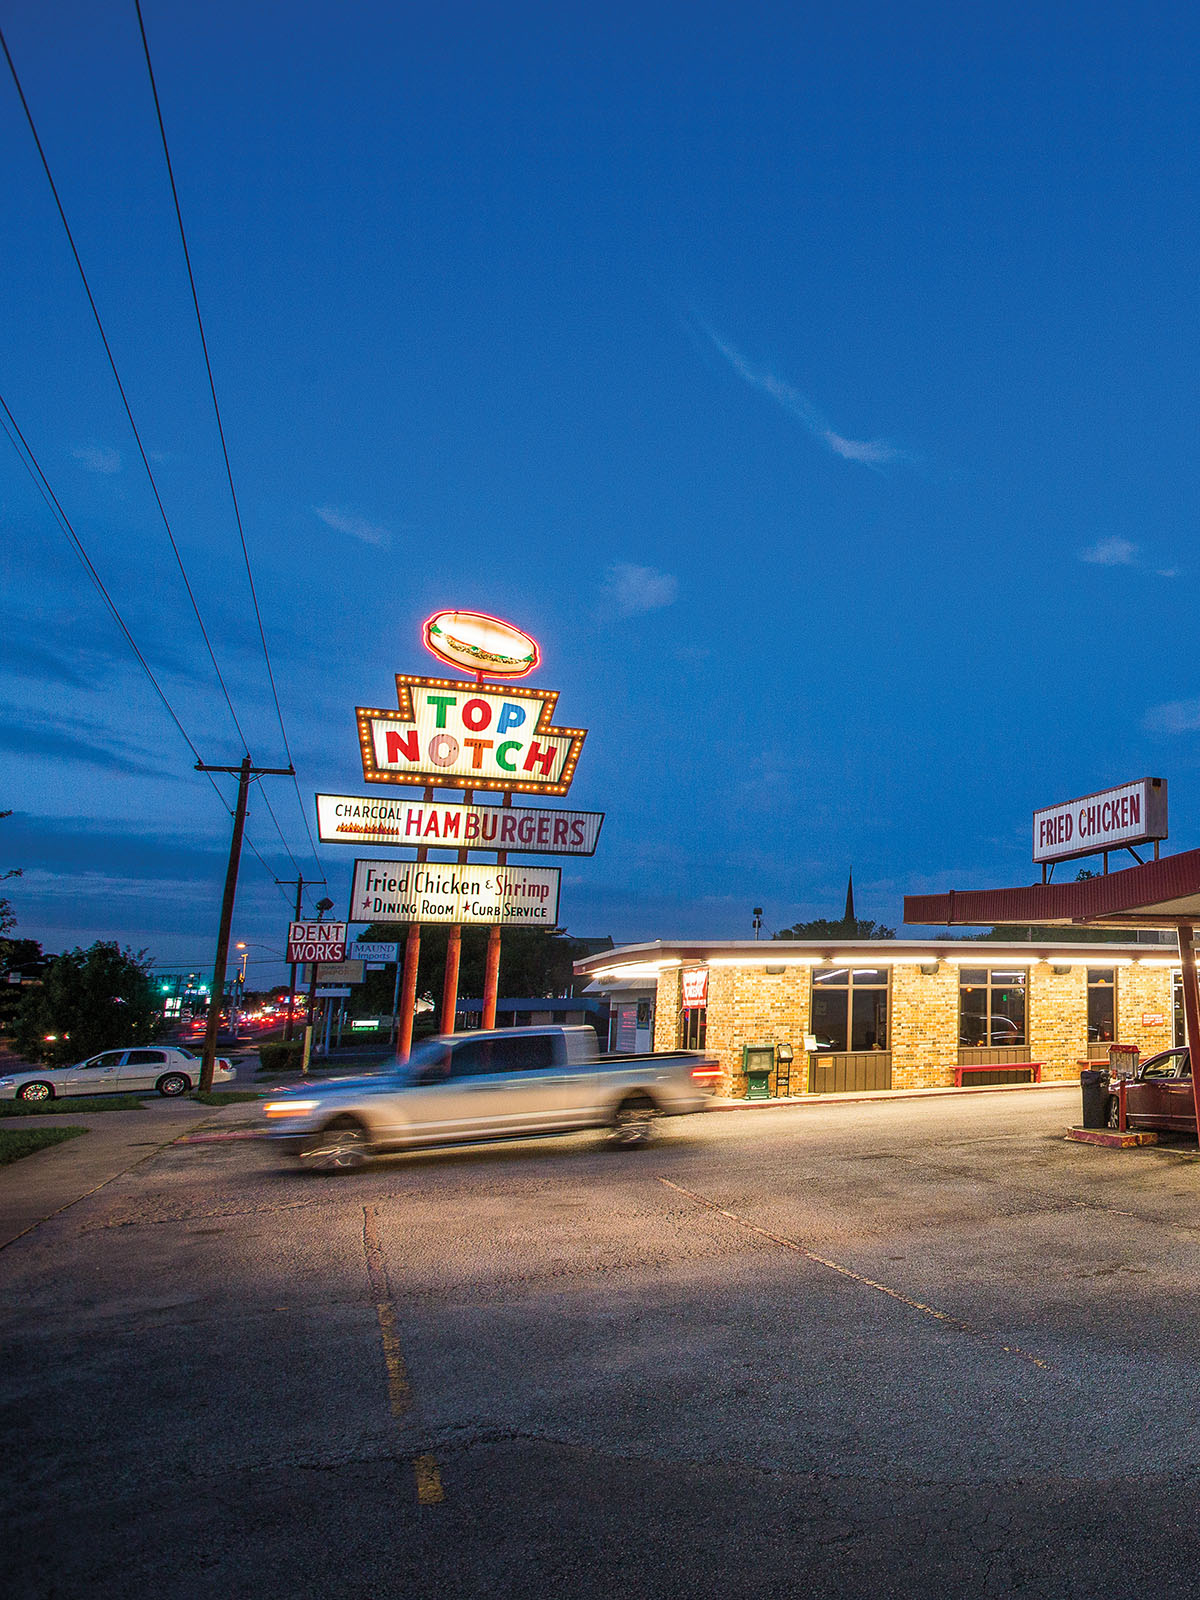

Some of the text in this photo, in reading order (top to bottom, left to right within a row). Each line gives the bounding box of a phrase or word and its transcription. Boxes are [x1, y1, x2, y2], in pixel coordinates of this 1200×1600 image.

[426, 695, 526, 735] TOP
[385, 729, 557, 777] NOTCH
[335, 804, 585, 846] CHARCOAL HAMBURGERS
[1039, 793, 1141, 849] FRIED CHICKEN
[366, 869, 408, 893] Fried
[415, 871, 480, 895] Chicken
[494, 874, 550, 902] Shrimp
[373, 901, 547, 918] DINING ROOM CURB SERVICE
[292, 925, 344, 941] DENT
[354, 944, 395, 953] MAUND
[291, 944, 342, 961] WORKS
